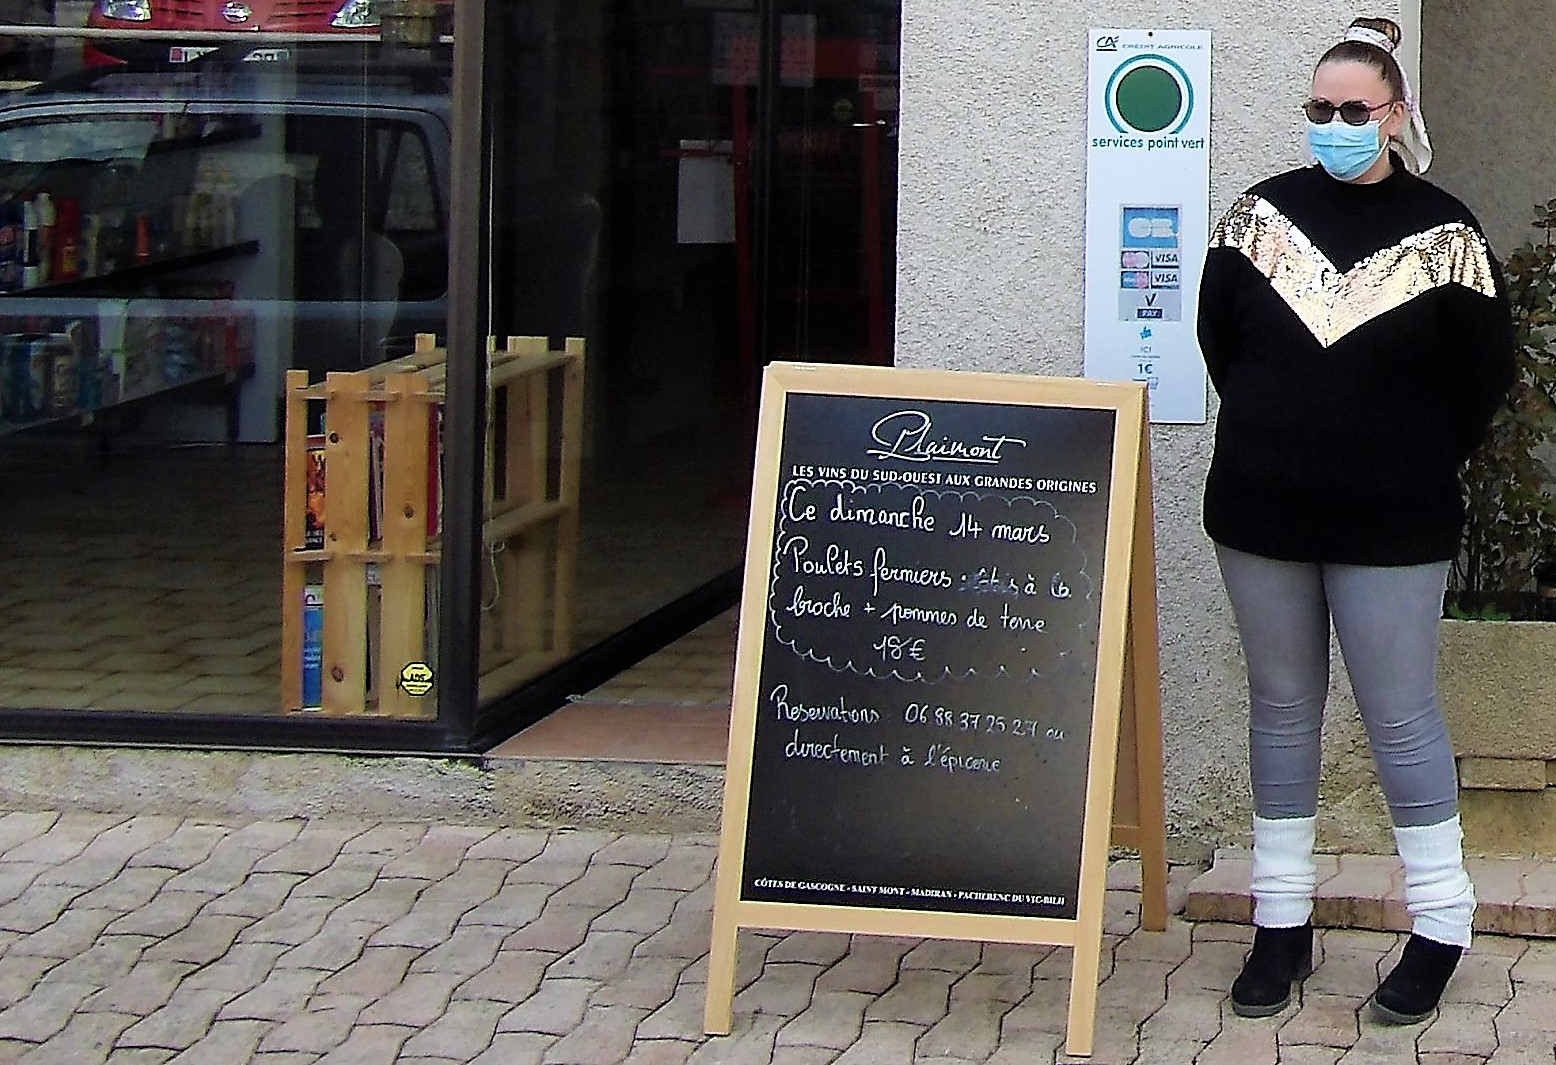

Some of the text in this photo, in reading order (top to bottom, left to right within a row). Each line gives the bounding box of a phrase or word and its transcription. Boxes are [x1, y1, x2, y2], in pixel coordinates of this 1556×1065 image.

[1092, 135, 1205, 151] services point vert
[1155, 254, 1178, 263] VISA
[1155, 273, 1178, 283] VISA
[866, 410, 1026, 464] Plaimont
[792, 465, 1097, 494] LES VINS DU SUD-OUEST AUX GRANDES ORIGINES
[788, 486, 1050, 543] Ce dimanche 14 mars
[783, 536, 863, 576] Poulets
[870, 547, 952, 597] fermiers
[1024, 574, 1037, 595] à
[786, 586, 850, 618] broche
[880, 604, 957, 625] pommes
[966, 608, 989, 628] de
[1000, 603, 1048, 633] terre
[904, 703, 928, 724] 06
[934, 707, 955, 727] 88
[959, 711, 981, 732] 37
[785, 729, 889, 766] directement
[900, 748, 914, 767] à
[754, 877, 784, 888] CÔTES
[784, 880, 797, 889] DE
[798, 881, 846, 892] GASCOGNE
[851, 884, 878, 894] SAINT
[879, 886, 905, 896] MONT
[911, 888, 952, 898] MADIRAN
[1012, 894, 1025, 903] DU
